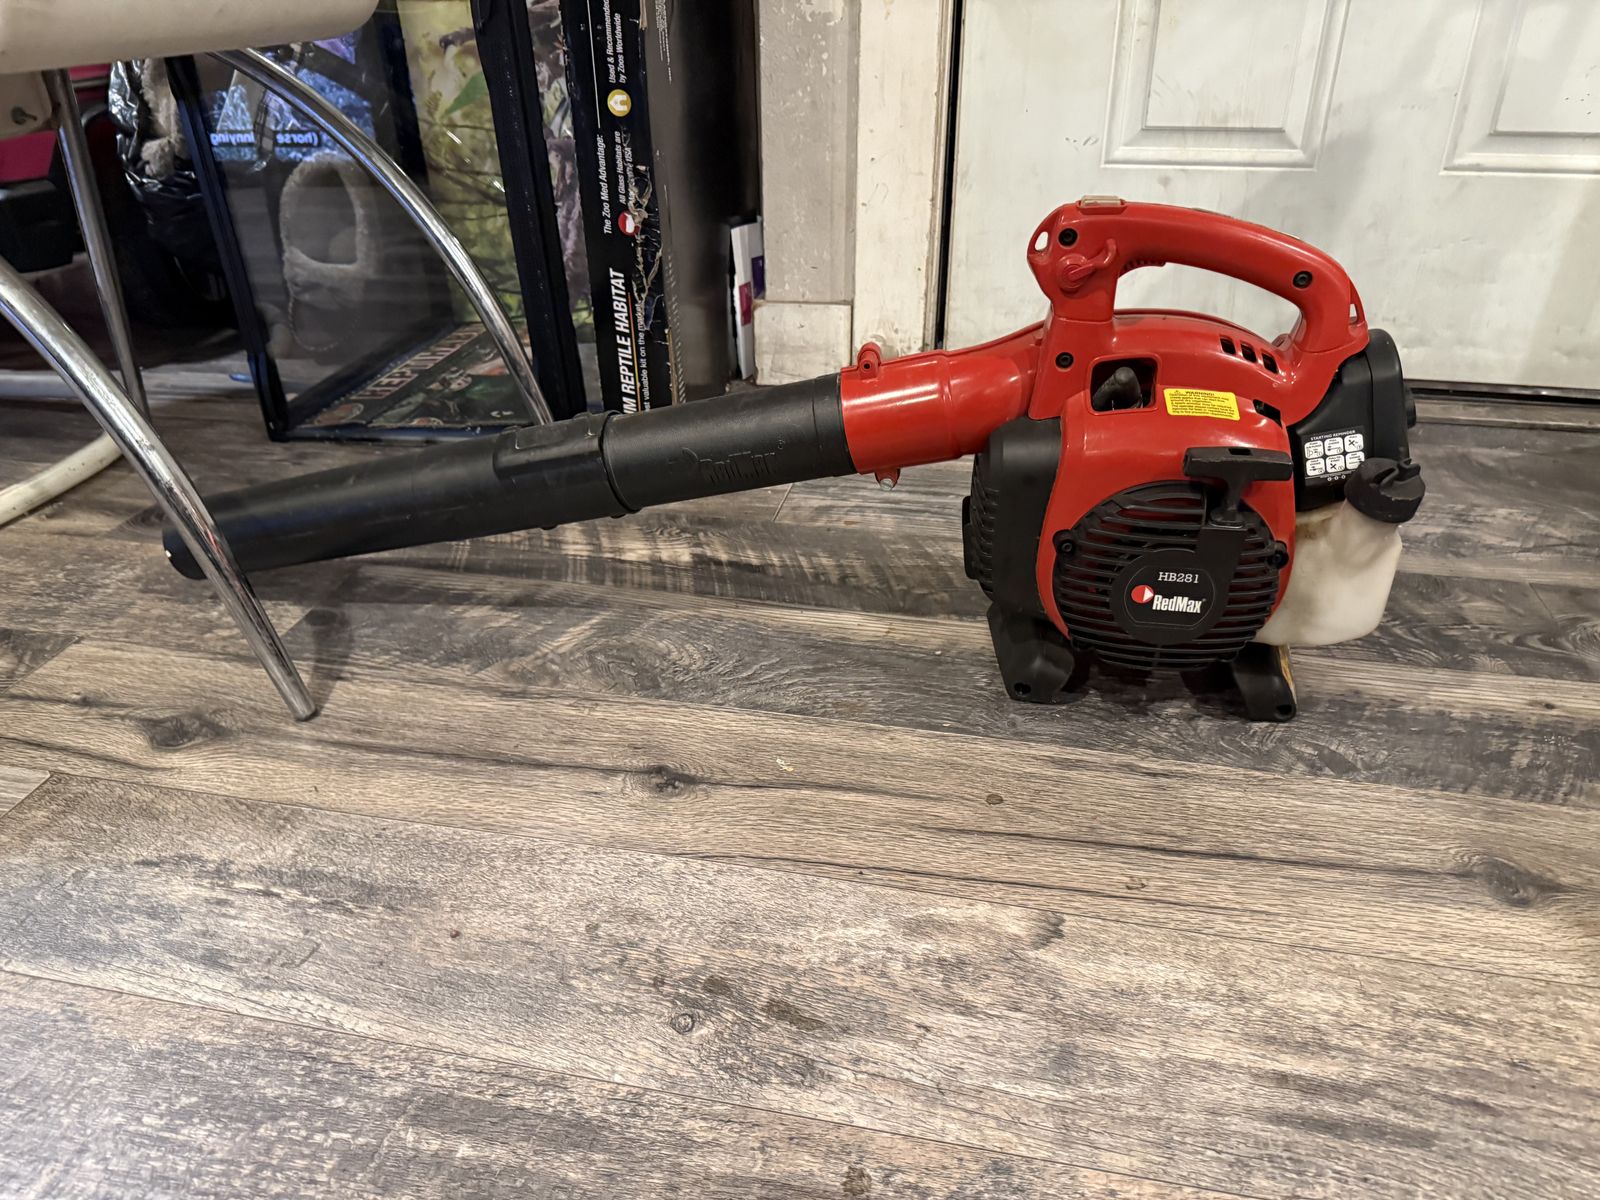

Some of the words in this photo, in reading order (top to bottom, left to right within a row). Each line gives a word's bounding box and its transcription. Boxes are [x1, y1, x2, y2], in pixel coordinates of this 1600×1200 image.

[612, 13, 623, 53] Worldwide
[606, 64, 617, 83] Used
[615, 54, 625, 74] Zoos
[617, 73, 627, 84] by
[597, 134, 607, 182] Advantage:
[615, 145, 624, 174] Habitats
[624, 147, 633, 162] USA
[600, 182, 609, 201] Med
[618, 174, 626, 194] Glass
[619, 194, 627, 205] All
[602, 202, 611, 220] Zoo
[604, 219, 612, 234] The
[609, 267, 630, 334] HABITAT
[638, 332, 646, 345] the
[639, 346, 647, 357] on
[616, 335, 636, 395] REPTILE
[640, 358, 648, 368] kit
[641, 369, 650, 400] valuable
[1158, 571, 1200, 584] HB281
[1152, 594, 1203, 614] RedMax
